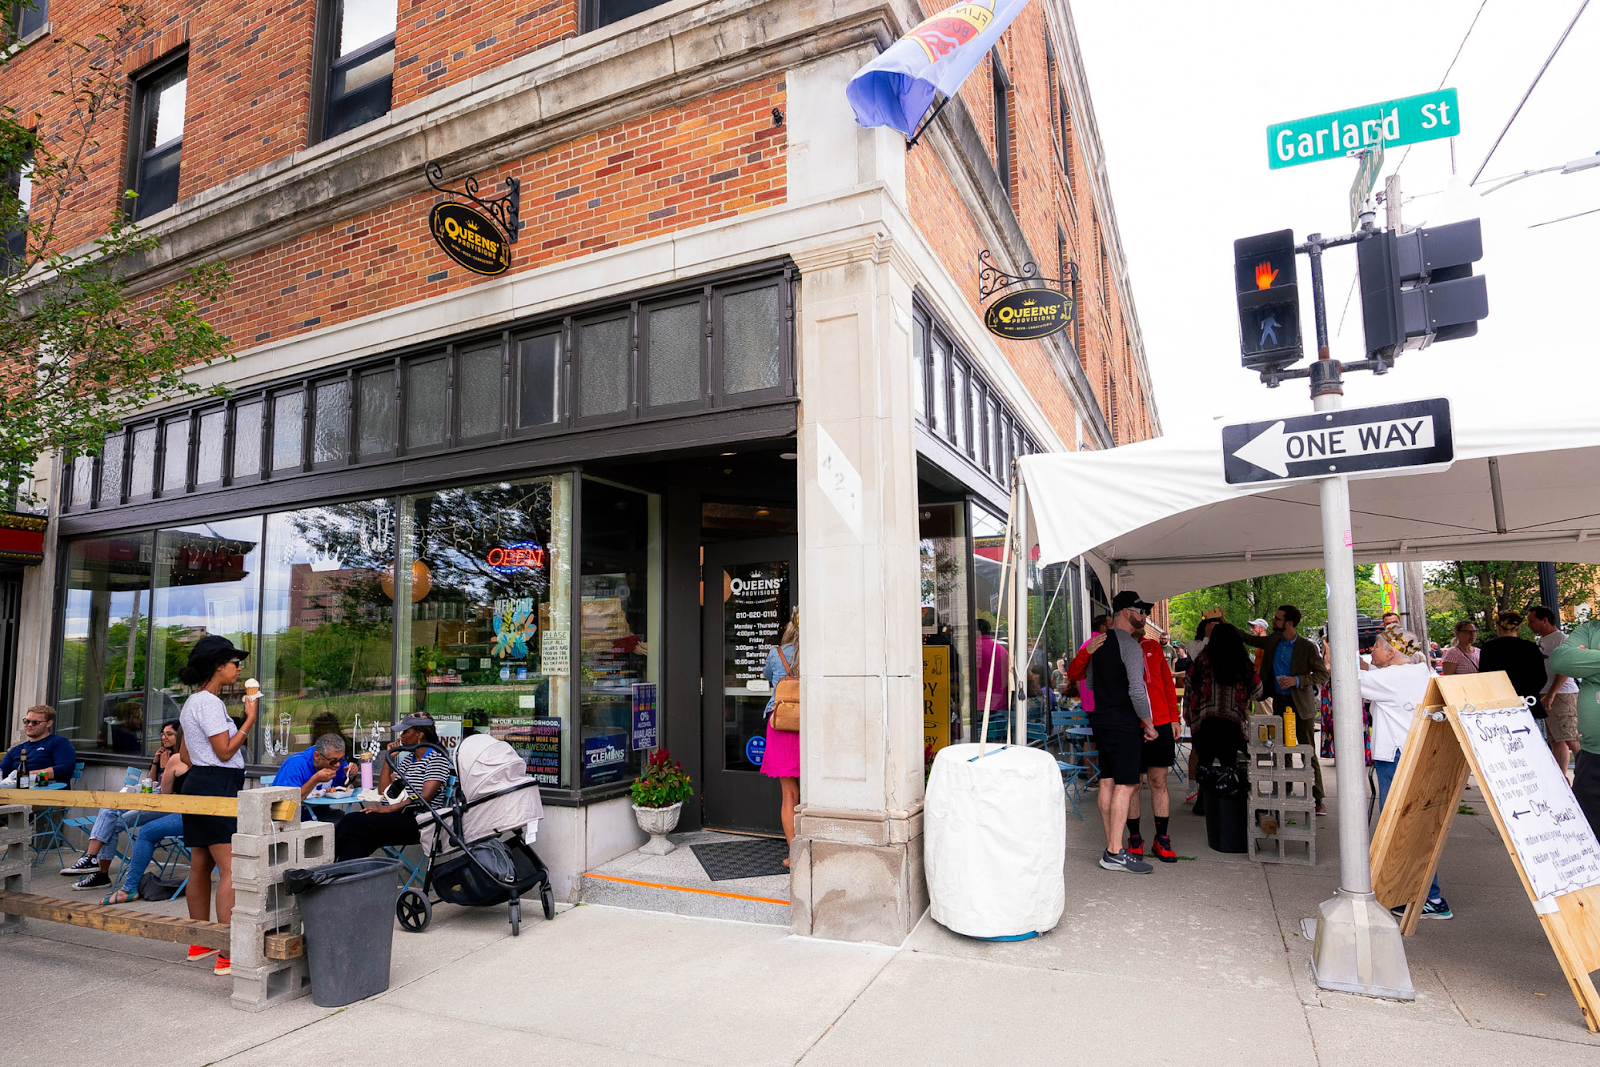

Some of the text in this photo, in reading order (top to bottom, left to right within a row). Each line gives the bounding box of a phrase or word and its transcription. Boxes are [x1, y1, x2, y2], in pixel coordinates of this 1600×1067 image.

[1277, 107, 1400, 161] Garland
[1421, 101, 1450, 129] St
[445, 217, 499, 253] QUEENS'
[458, 238, 496, 259] PROVISIONS
[999, 304, 1060, 323] QUEENS'
[1012, 315, 1055, 324] PROVISIONS
[1286, 420, 1423, 458] ONE WAY
[488, 548, 545, 567] OPEN
[730, 578, 783, 595] QUEENS'
[494, 598, 533, 613] WELCOME
[533, 727, 558, 735] DIVERSITY
[634, 728, 655, 739] AVAILABLE
[1476, 719, 1512, 743] Sporting
[526, 743, 558, 752] AWESOME
[1500, 736, 1524, 754] Events
[531, 758, 558, 766] WELCOME
[534, 774, 558, 784] EVERYONE
[1529, 800, 1550, 817] Drink
[1550, 808, 1575, 827] Specials
